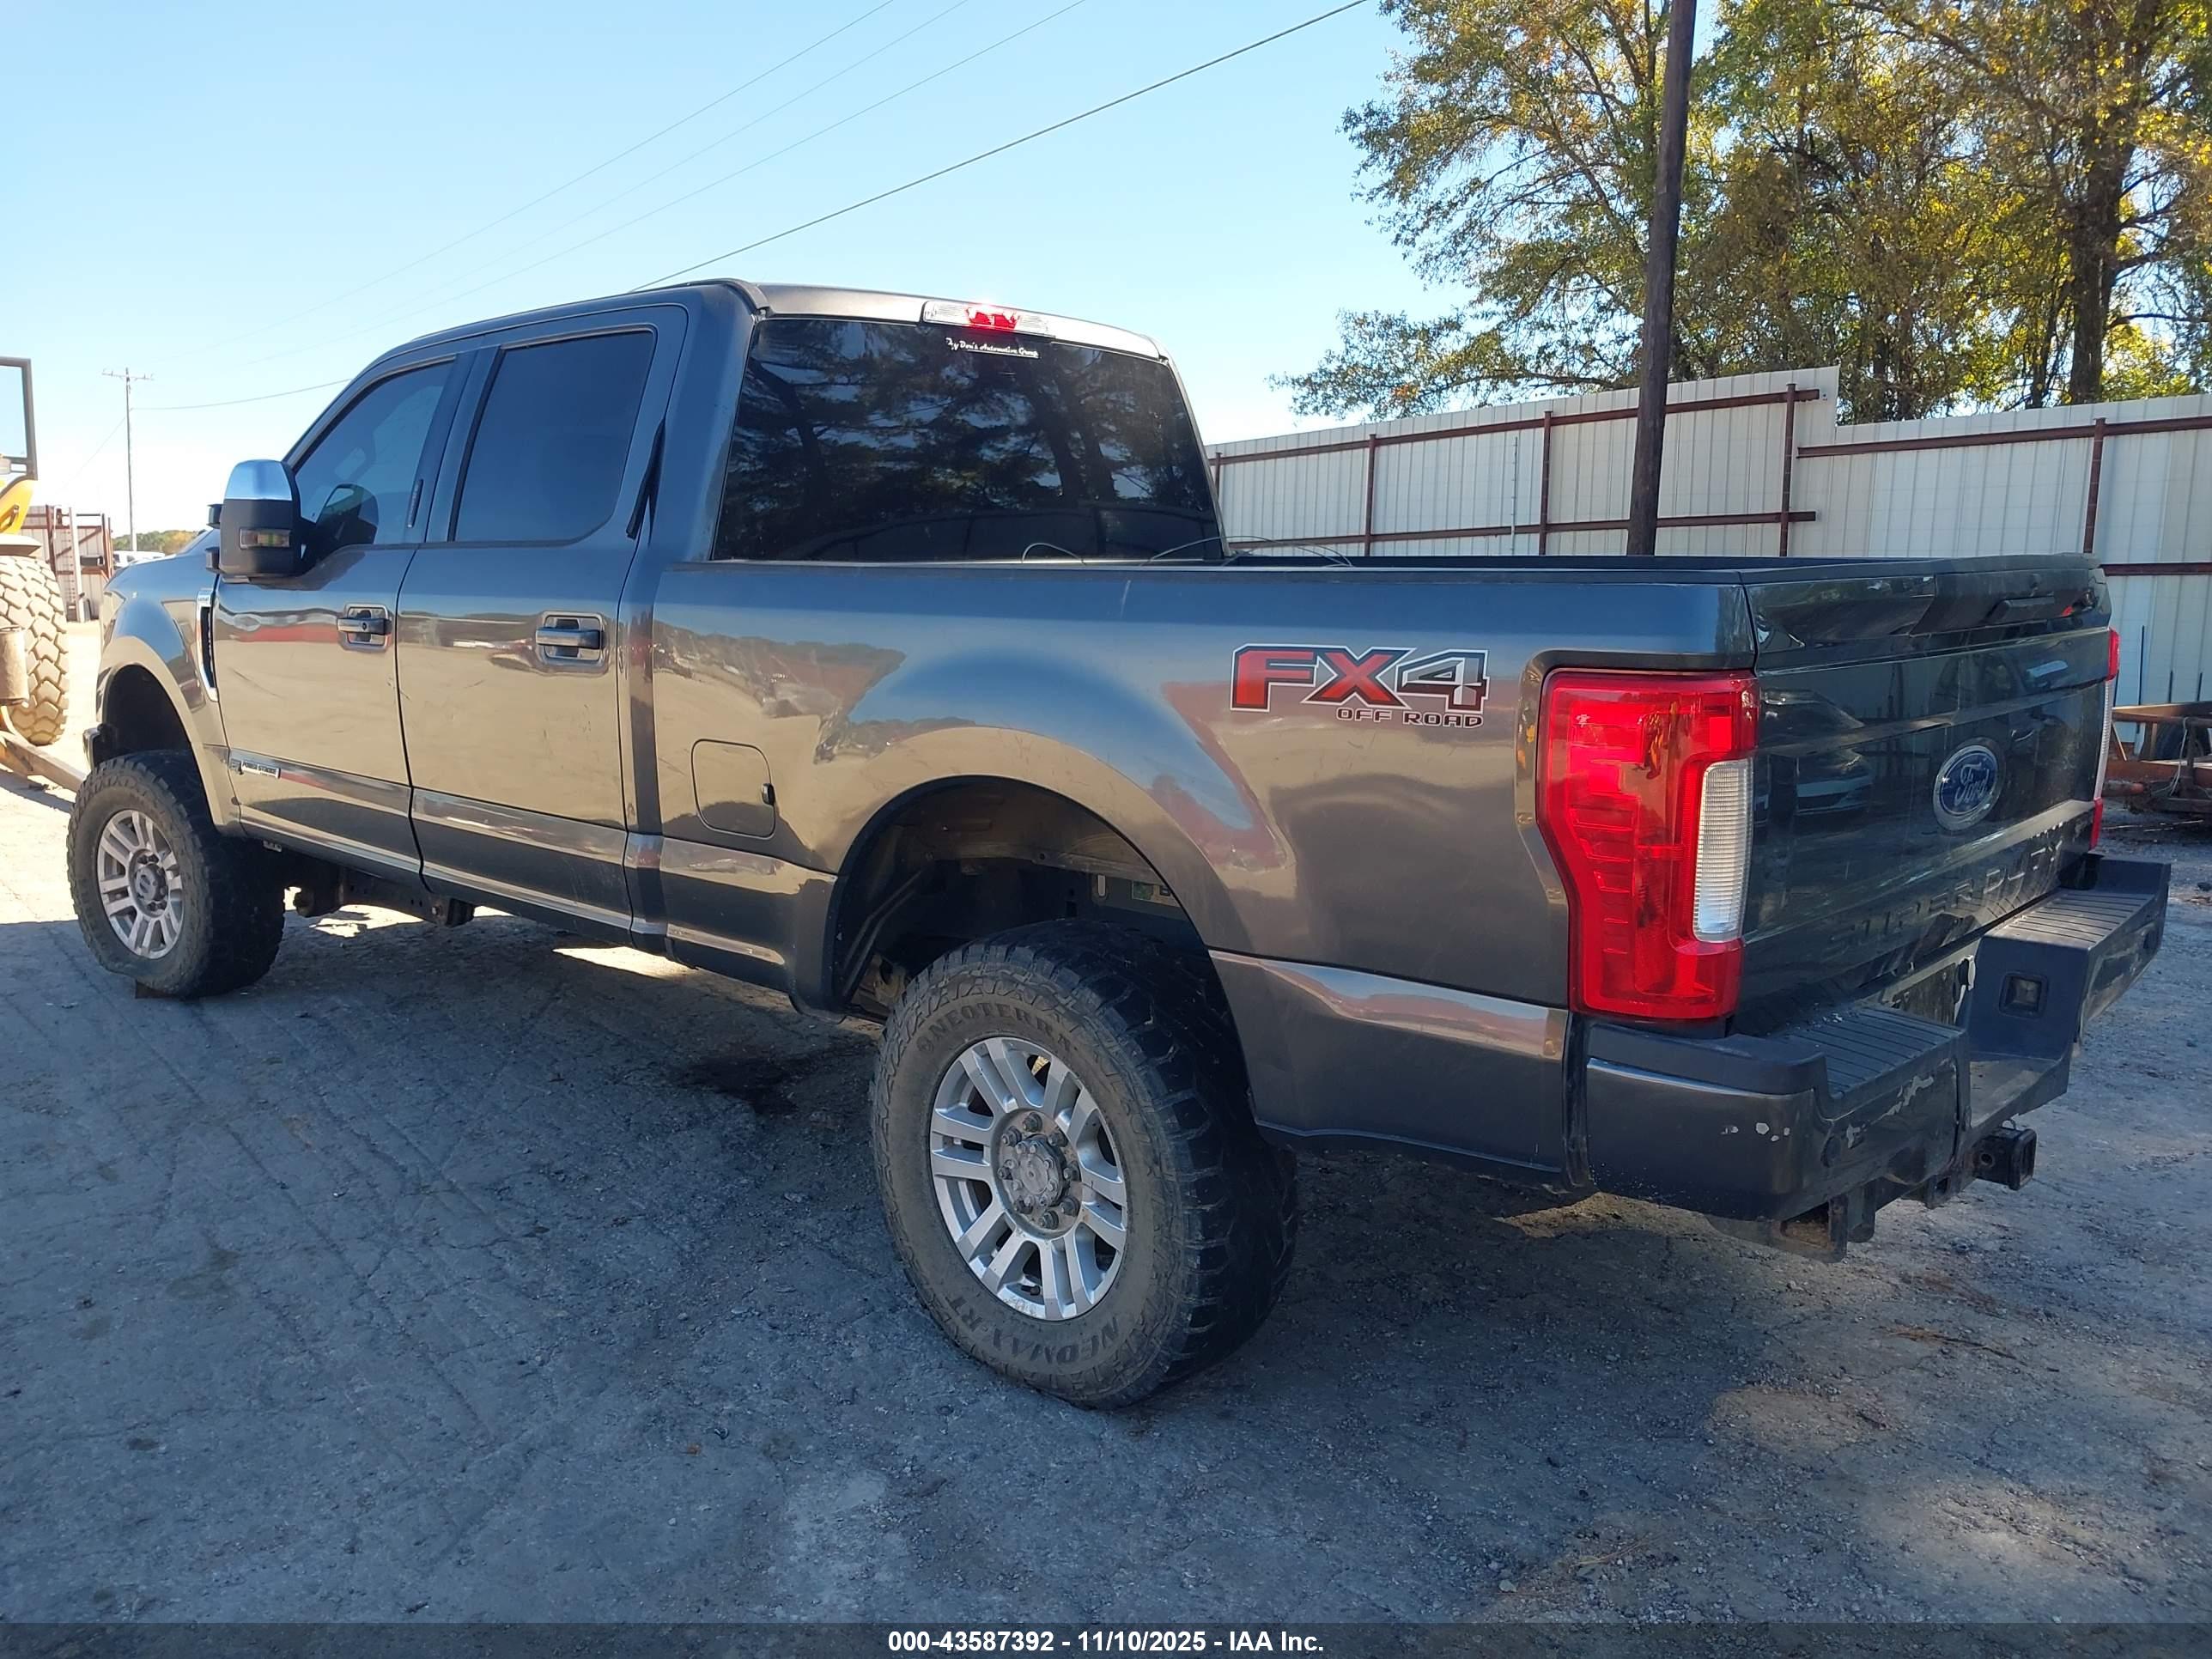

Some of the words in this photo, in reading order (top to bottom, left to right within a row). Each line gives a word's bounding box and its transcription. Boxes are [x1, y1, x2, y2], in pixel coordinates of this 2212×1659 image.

[1230, 643, 1490, 714] FX4
[1336, 708, 1392, 722] OFF
[1403, 712, 1484, 728] ROAD
